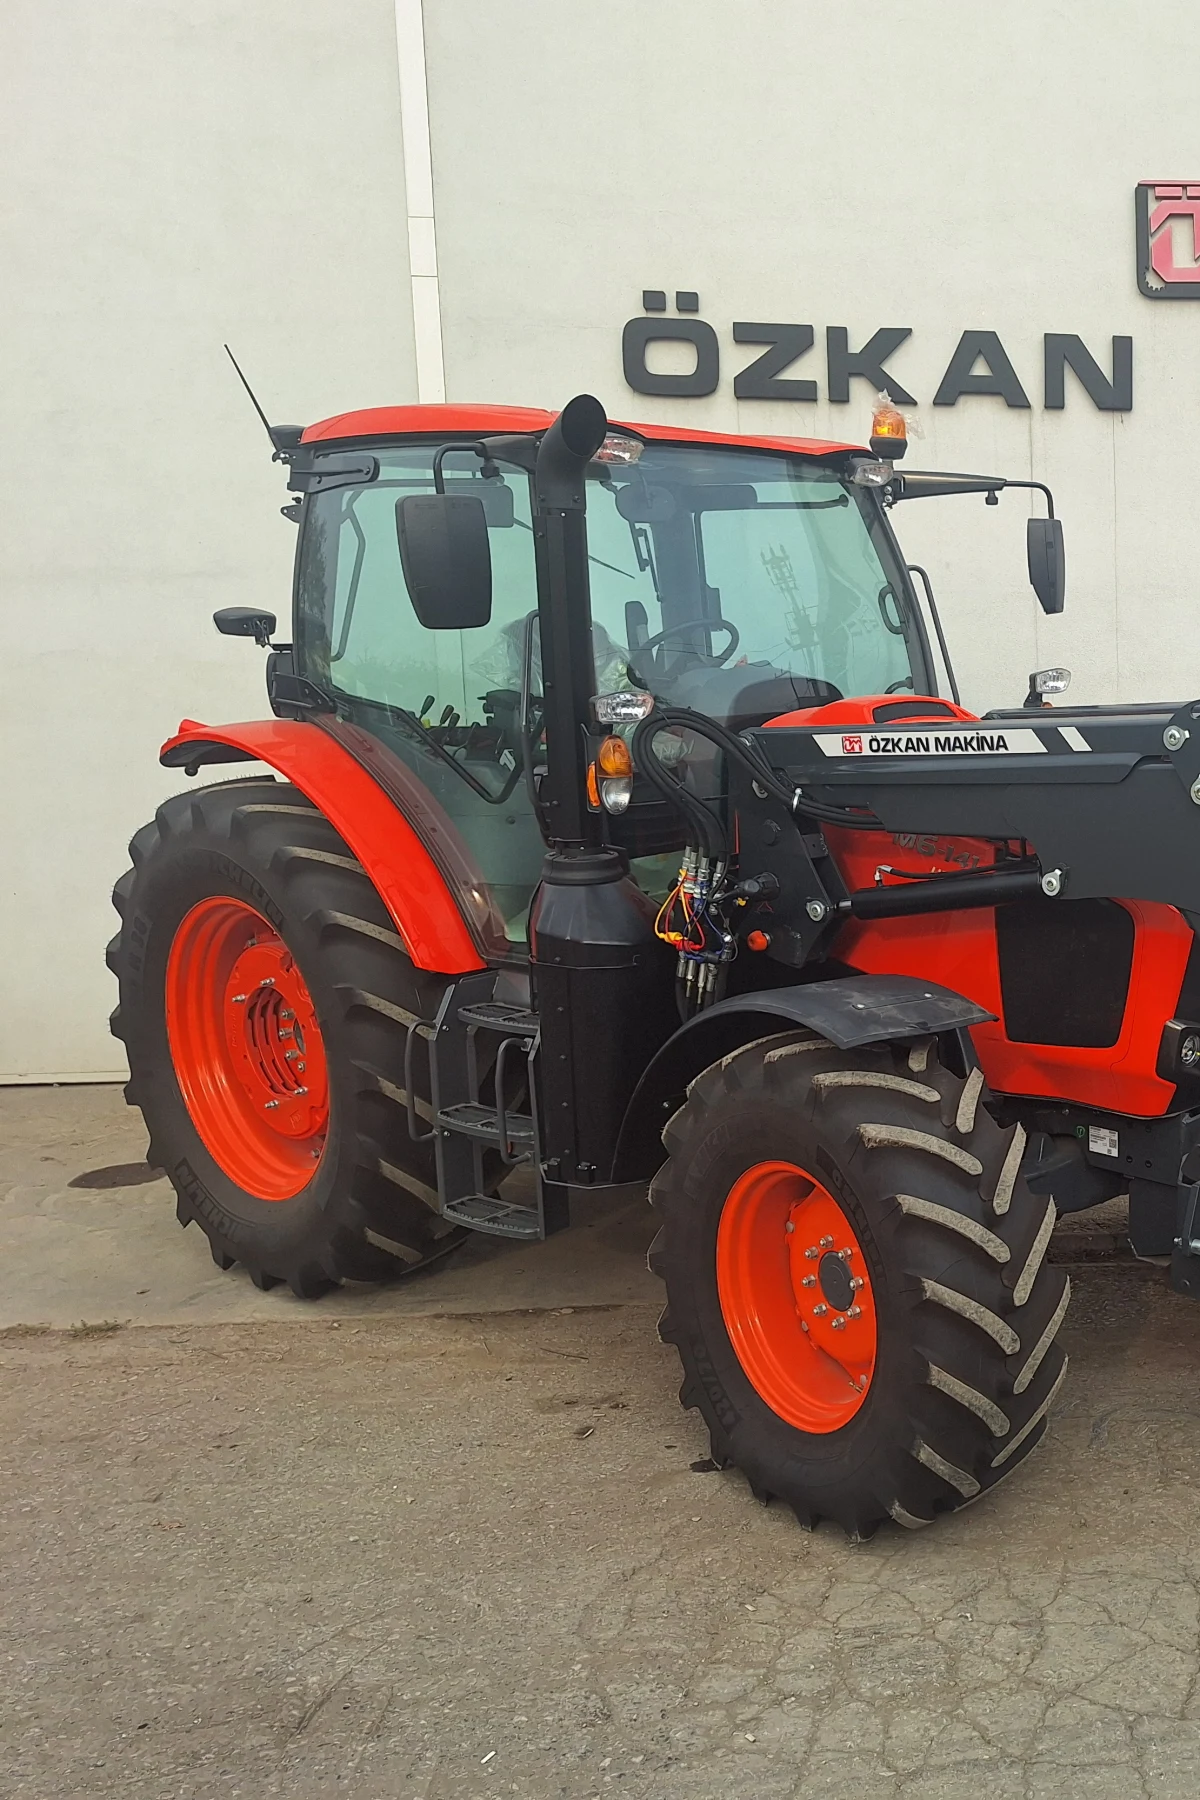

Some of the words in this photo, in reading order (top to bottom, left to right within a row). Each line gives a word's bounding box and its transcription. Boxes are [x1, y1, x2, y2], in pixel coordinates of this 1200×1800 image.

[622, 290, 1133, 411] ÖZKAN
[868, 735, 930, 753] ÖZKAN
[934, 732, 1009, 752] MAKİNA
